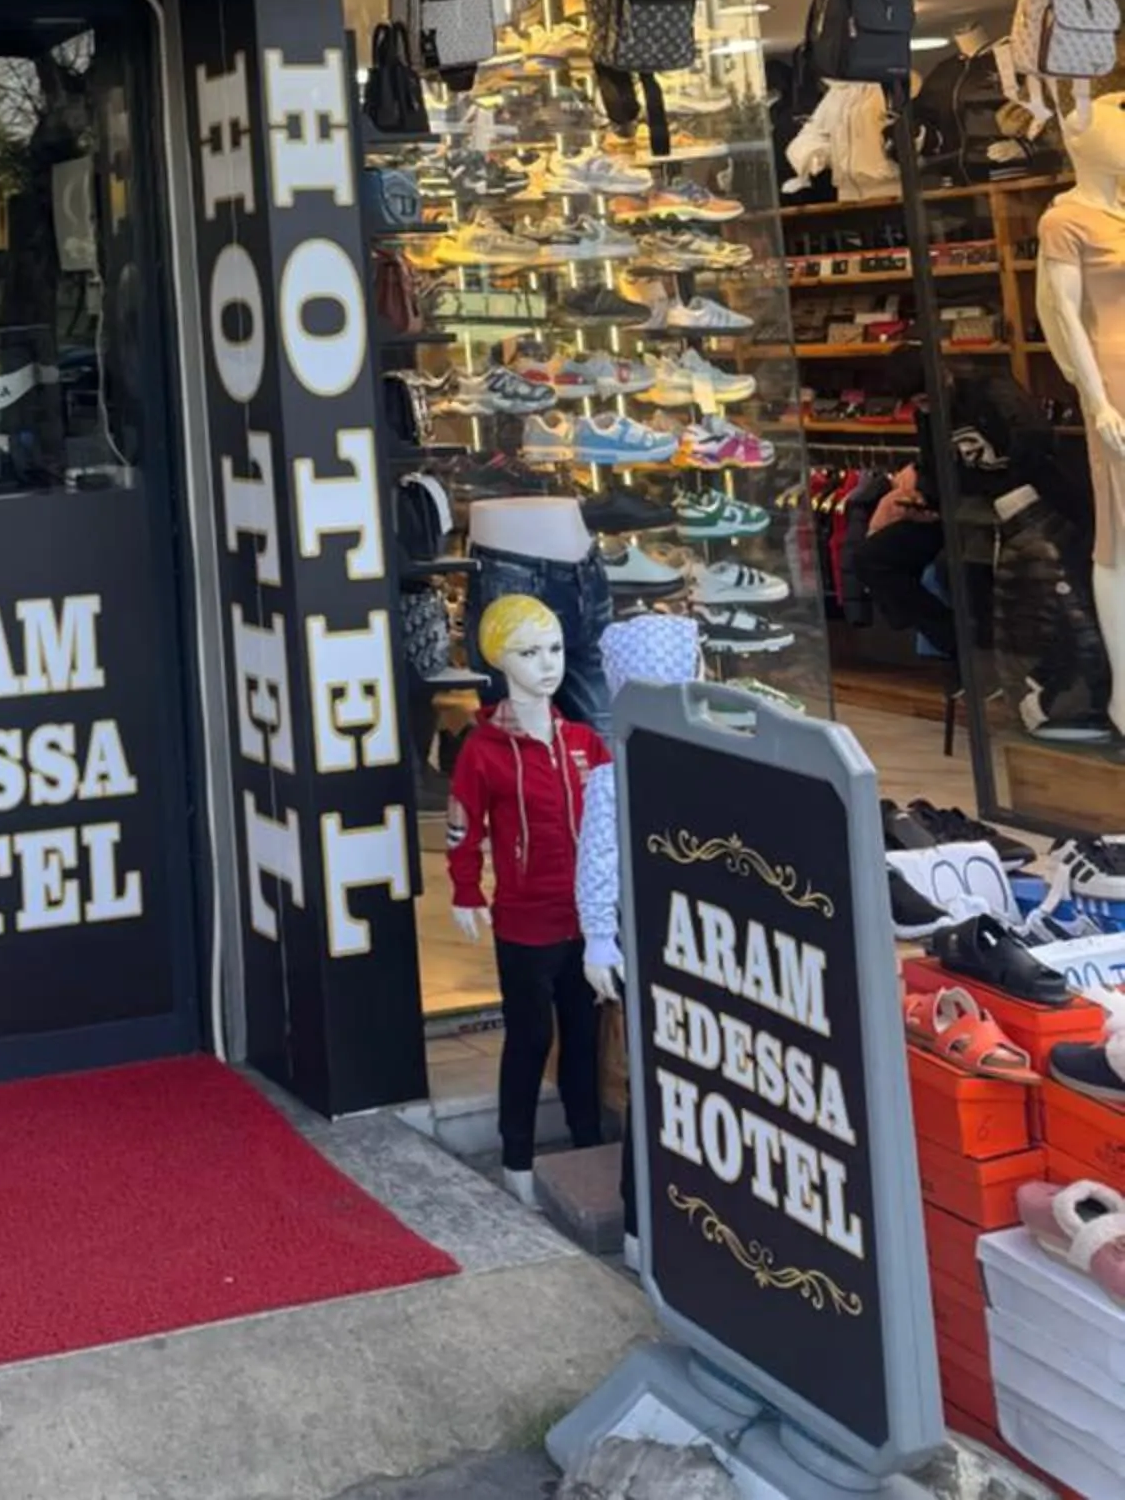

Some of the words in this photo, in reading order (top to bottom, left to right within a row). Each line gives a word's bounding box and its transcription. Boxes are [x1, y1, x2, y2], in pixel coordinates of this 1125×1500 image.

[195, 49, 305, 942] HOTEL
[264, 46, 411, 958] HOTEL
[663, 890, 831, 1038] ARAM
[651, 984, 857, 1147] EDESSA
[657, 1068, 864, 1260] HOTEL
